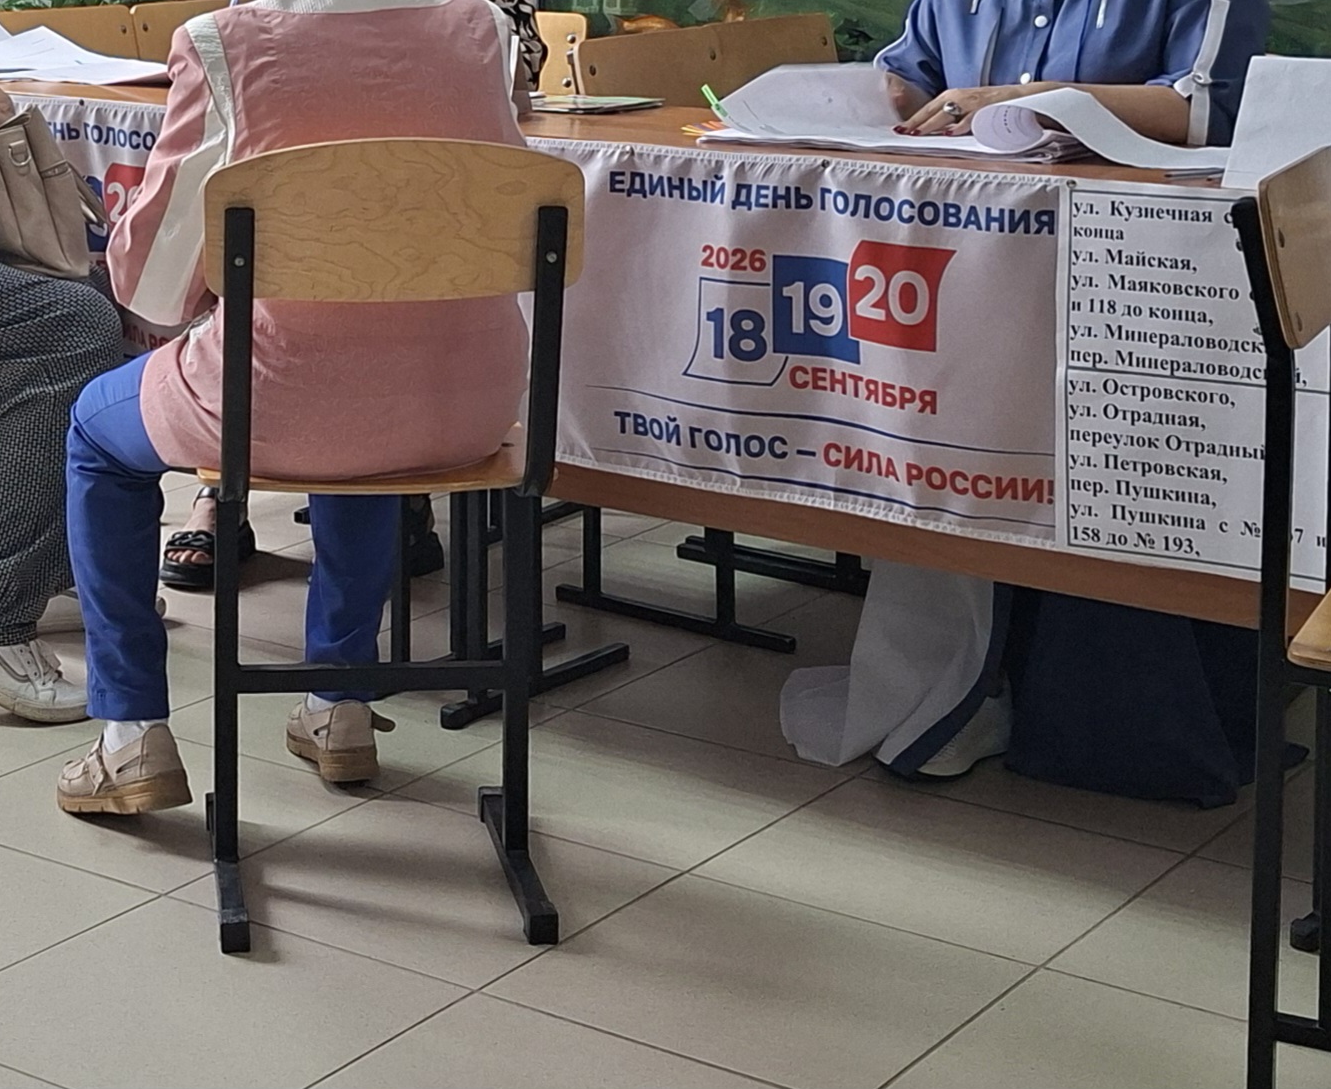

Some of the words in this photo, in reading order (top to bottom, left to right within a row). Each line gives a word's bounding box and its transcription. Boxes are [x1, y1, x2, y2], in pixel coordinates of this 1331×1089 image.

[83, 122, 159, 152] ГОЛОСО
[608, 169, 726, 207] ЕДИНЫЙ
[731, 181, 813, 213] ДЕНЬ
[819, 186, 1056, 236] ГОЛОСОВАНИЯ
[1072, 202, 1100, 218] ул.
[1110, 200, 1213, 223] Кузнечная
[1073, 225, 1125, 241] конца
[700, 243, 767, 273] 2026
[1072, 249, 1099, 265] ул.
[1105, 248, 1198, 275] Майская,
[1071, 274, 1099, 291] ул.
[1108, 273, 1240, 301] Маяковского
[706, 307, 768, 363] 18
[782, 280, 844, 338] 19
[853, 263, 931, 326] 20
[1071, 300, 1081, 312] и
[1088, 298, 1117, 315] 118
[1121, 304, 1143, 318] до
[1148, 306, 1214, 327] конца,
[1070, 323, 1098, 340] ул.
[1104, 323, 1266, 354] Минераловодск
[1070, 349, 1108, 369] пер.
[788, 365, 938, 416] СЕНТЯБРЯ
[1068, 379, 1097, 395] ул.
[1102, 378, 1236, 409] Островского,
[1068, 404, 1097, 420] ул.
[1102, 403, 1207, 431] Отрадная,
[1070, 428, 1160, 450] переулок
[613, 410, 682, 446] ТВОЙ
[688, 425, 789, 461] ГОЛОС
[823, 442, 901, 484] СИЛА
[906, 462, 1055, 506] РОССИИ!
[1069, 453, 1098, 470] ул.
[1104, 453, 1228, 485] Петровская,
[1070, 478, 1109, 497] пер.
[1115, 479, 1218, 509] Пушкина,
[1070, 503, 1099, 519] ул.
[1111, 504, 1207, 531] Пушкина
[1218, 521, 1228, 533] с
[1240, 521, 1262, 538] №
[1072, 526, 1101, 543] 158
[1106, 532, 1128, 546] до
[1133, 532, 1156, 550] №
[1162, 536, 1201, 557] 193,
